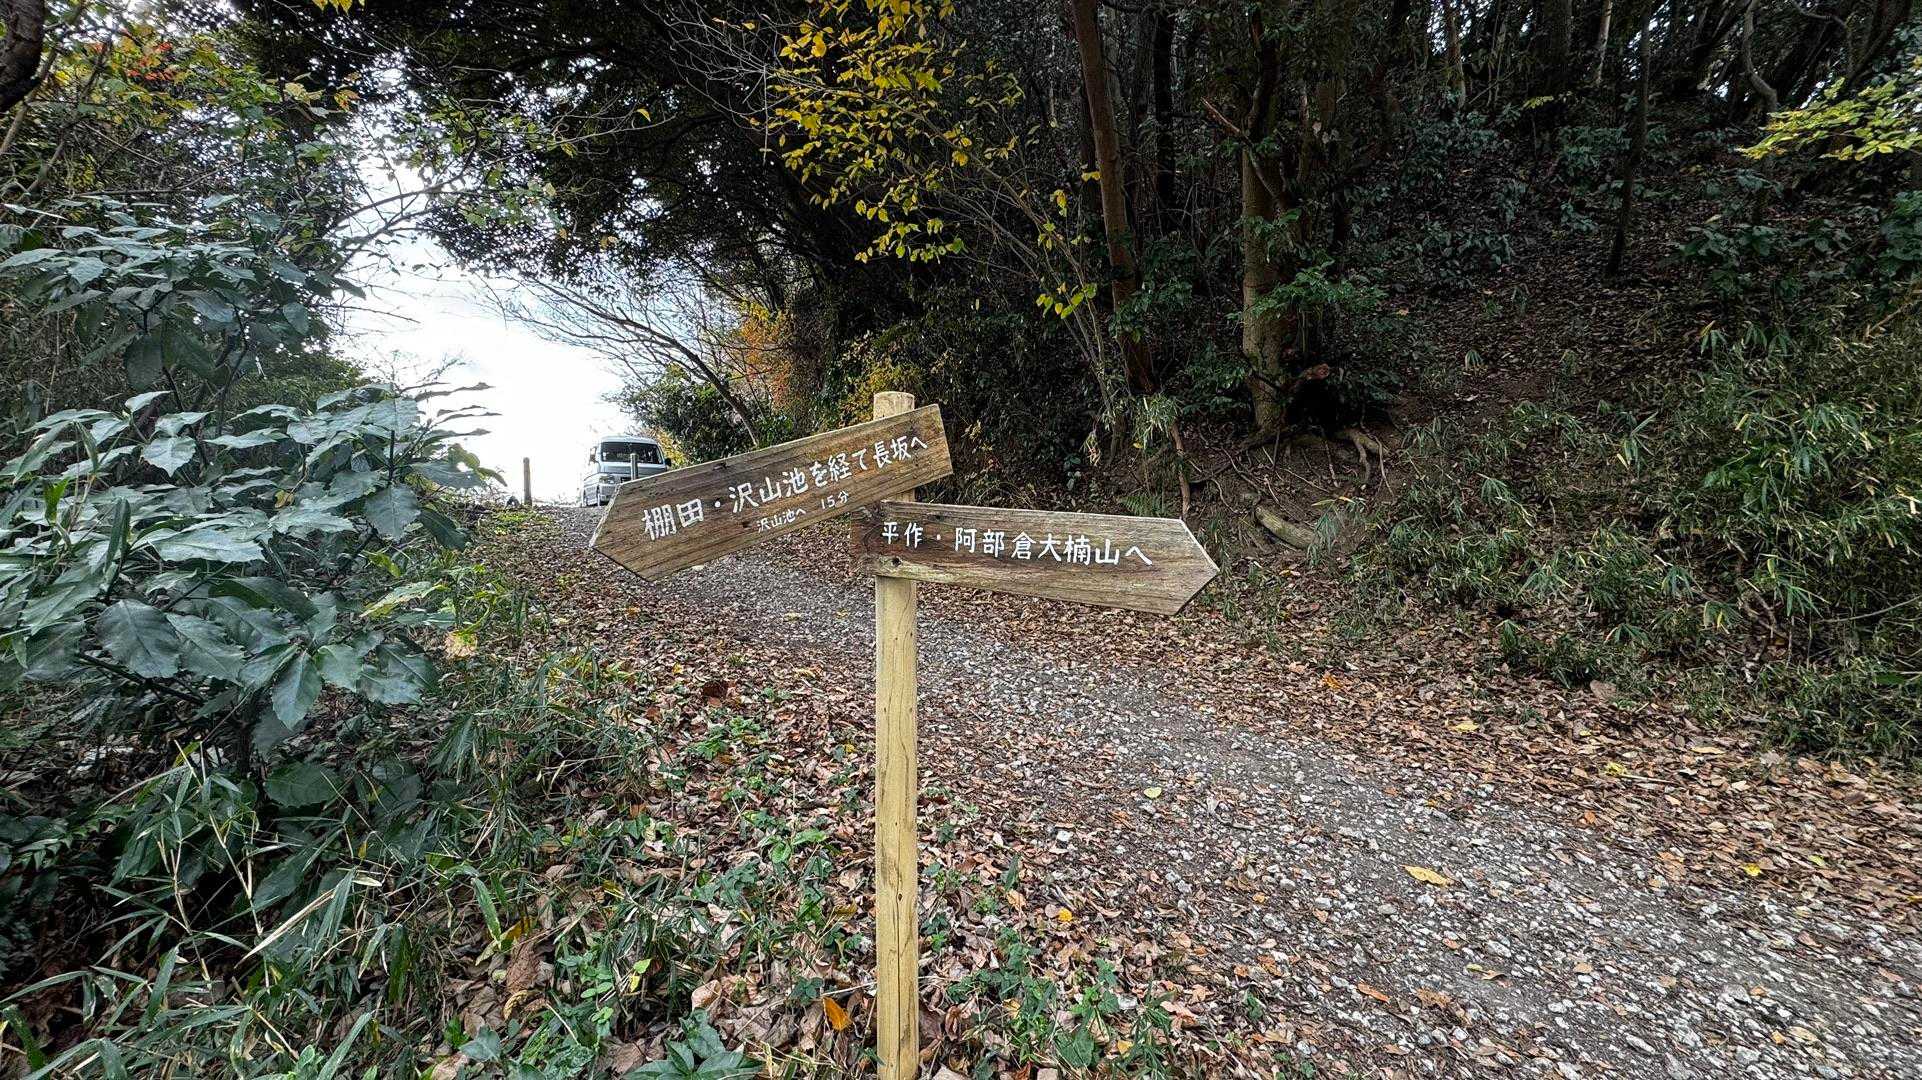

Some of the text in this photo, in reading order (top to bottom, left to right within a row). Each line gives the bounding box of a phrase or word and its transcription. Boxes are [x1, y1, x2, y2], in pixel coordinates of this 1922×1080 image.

[641, 435, 928, 540] 棚田・沢山池を経て長坂へ
[757, 490, 850, 533] 沢山池へ 15分
